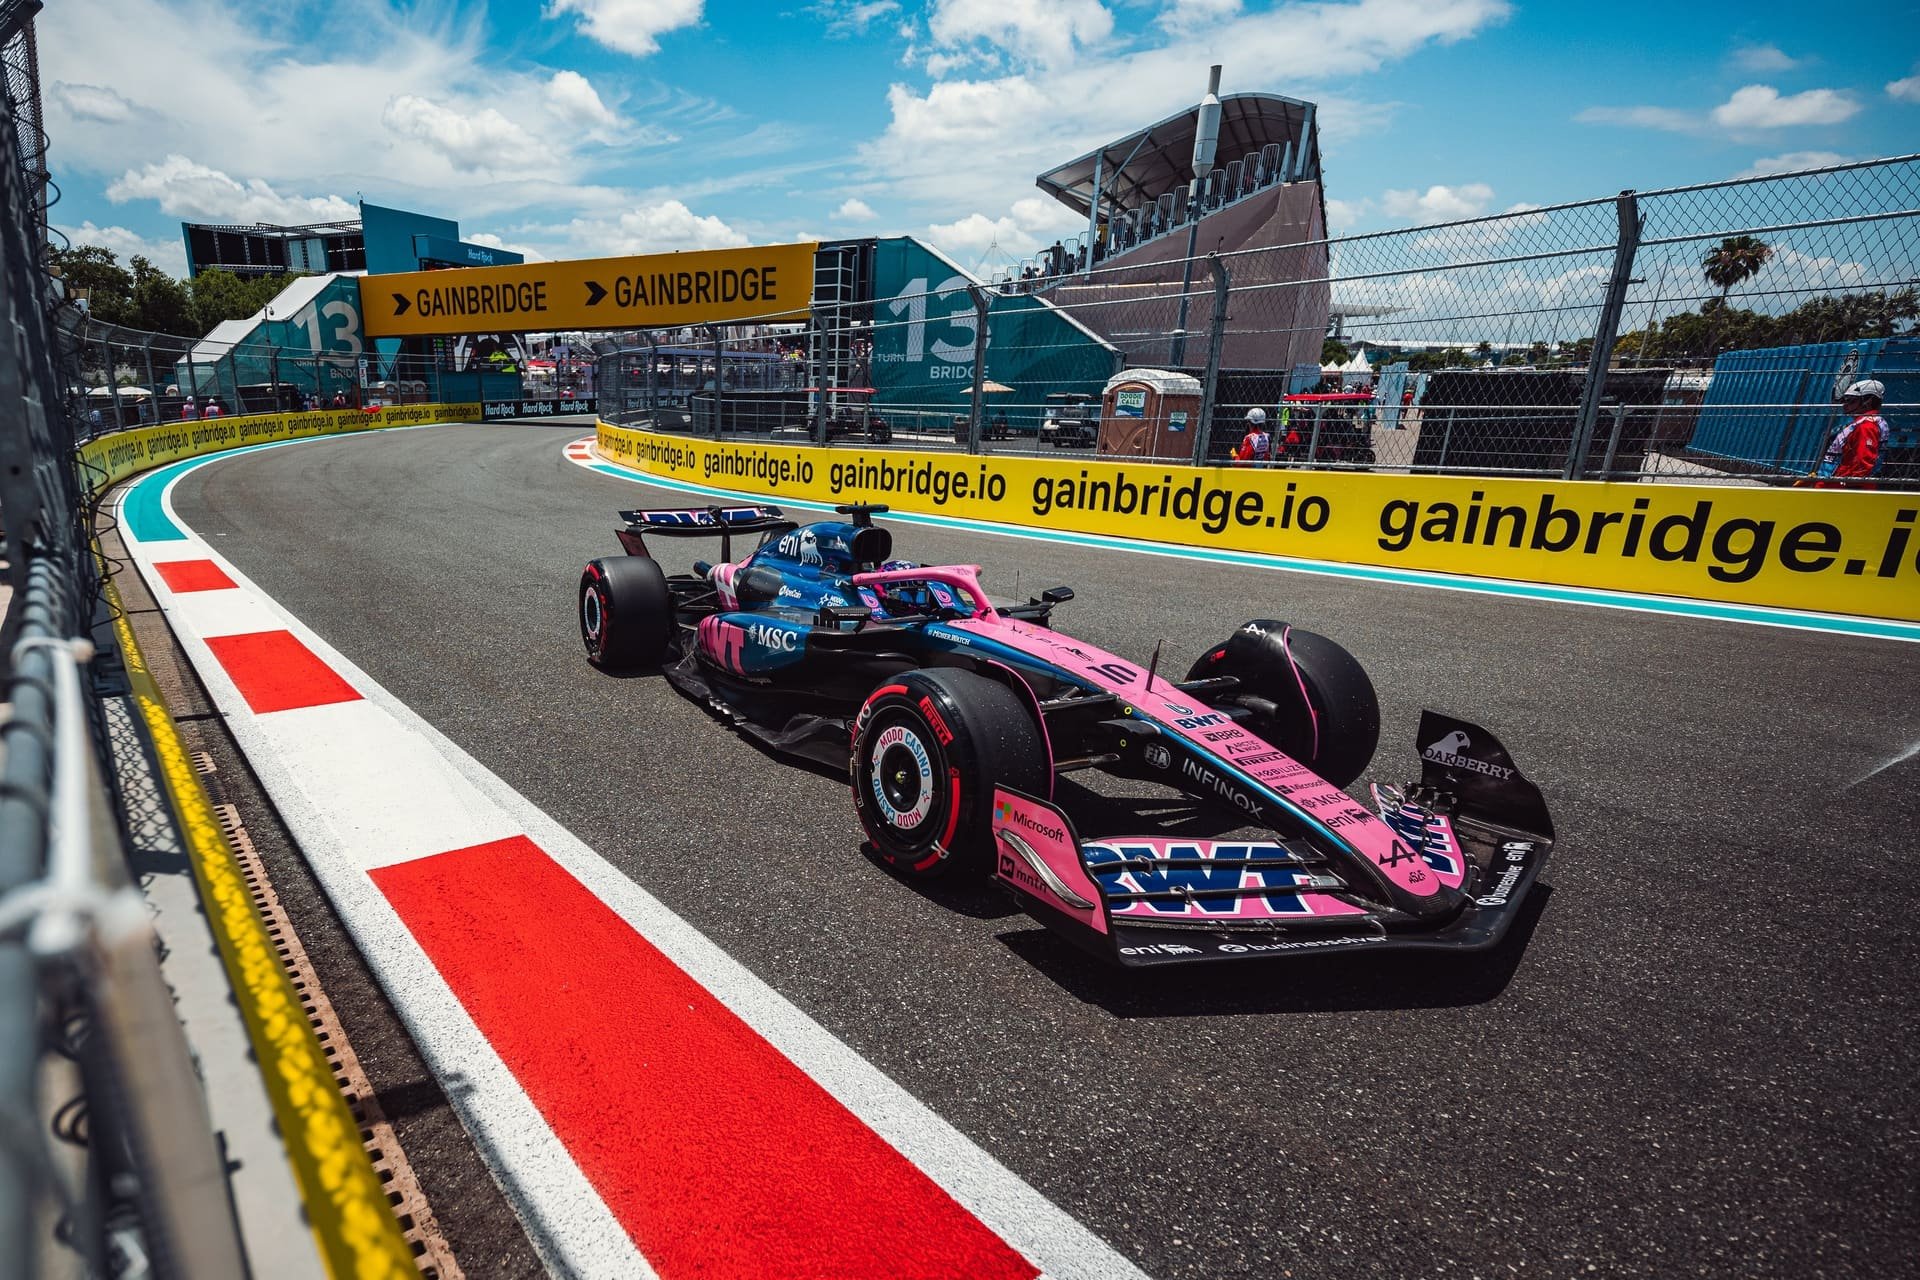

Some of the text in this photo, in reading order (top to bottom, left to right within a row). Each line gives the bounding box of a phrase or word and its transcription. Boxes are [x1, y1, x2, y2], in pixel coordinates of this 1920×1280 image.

[417, 281, 547, 317] GAINBRIDGE
[615, 267, 777, 308] GAINBRIDGE
[889, 275, 992, 362] 13
[293, 300, 363, 367] 13
[877, 353, 905, 362] TURN
[385, 406, 431, 424] gainbridge.io
[434, 403, 479, 421] gainbridge.io
[485, 404, 515, 417] Hard Rock
[522, 402, 553, 415] Hard Rock
[560, 401, 574, 412] Hard
[574, 400, 588, 412] Rock
[239, 417, 284, 442] gainbridge.io
[288, 413, 333, 434] gainbridge.io
[337, 410, 382, 429] gainbridge.io
[147, 428, 189, 460] gainbridge.io
[191, 420, 236, 449] gainbridge.io
[636, 438, 696, 472] gainbridge.io
[704, 449, 814, 487] gainbridge.io
[830, 461, 1006, 505] gainbridge.io
[1032, 470, 1331, 534] gainbridge.io
[779, 531, 802, 557] eni
[1378, 489, 1920, 584] gainbridge.i
[757, 625, 797, 652] MSC
[1085, 663, 1138, 685] 10
[1173, 712, 1226, 730] BWT
[1216, 729, 1245, 741] BRB
[880, 728, 931, 778] MODO CASINO
[1144, 746, 1168, 767] FIA
[1232, 751, 1287, 767] PIRELLI
[1422, 747, 1515, 781] OAKBERRY
[1182, 757, 1264, 820] INFINOX
[1312, 791, 1351, 806] MSC
[873, 778, 922, 828] MODO CASINO
[1013, 810, 1064, 843] Microsoft
[1325, 811, 1356, 828] eni
[1081, 842, 1316, 915] BWT
[1119, 943, 1161, 956] eni
[1257, 935, 1388, 952] businessolver
